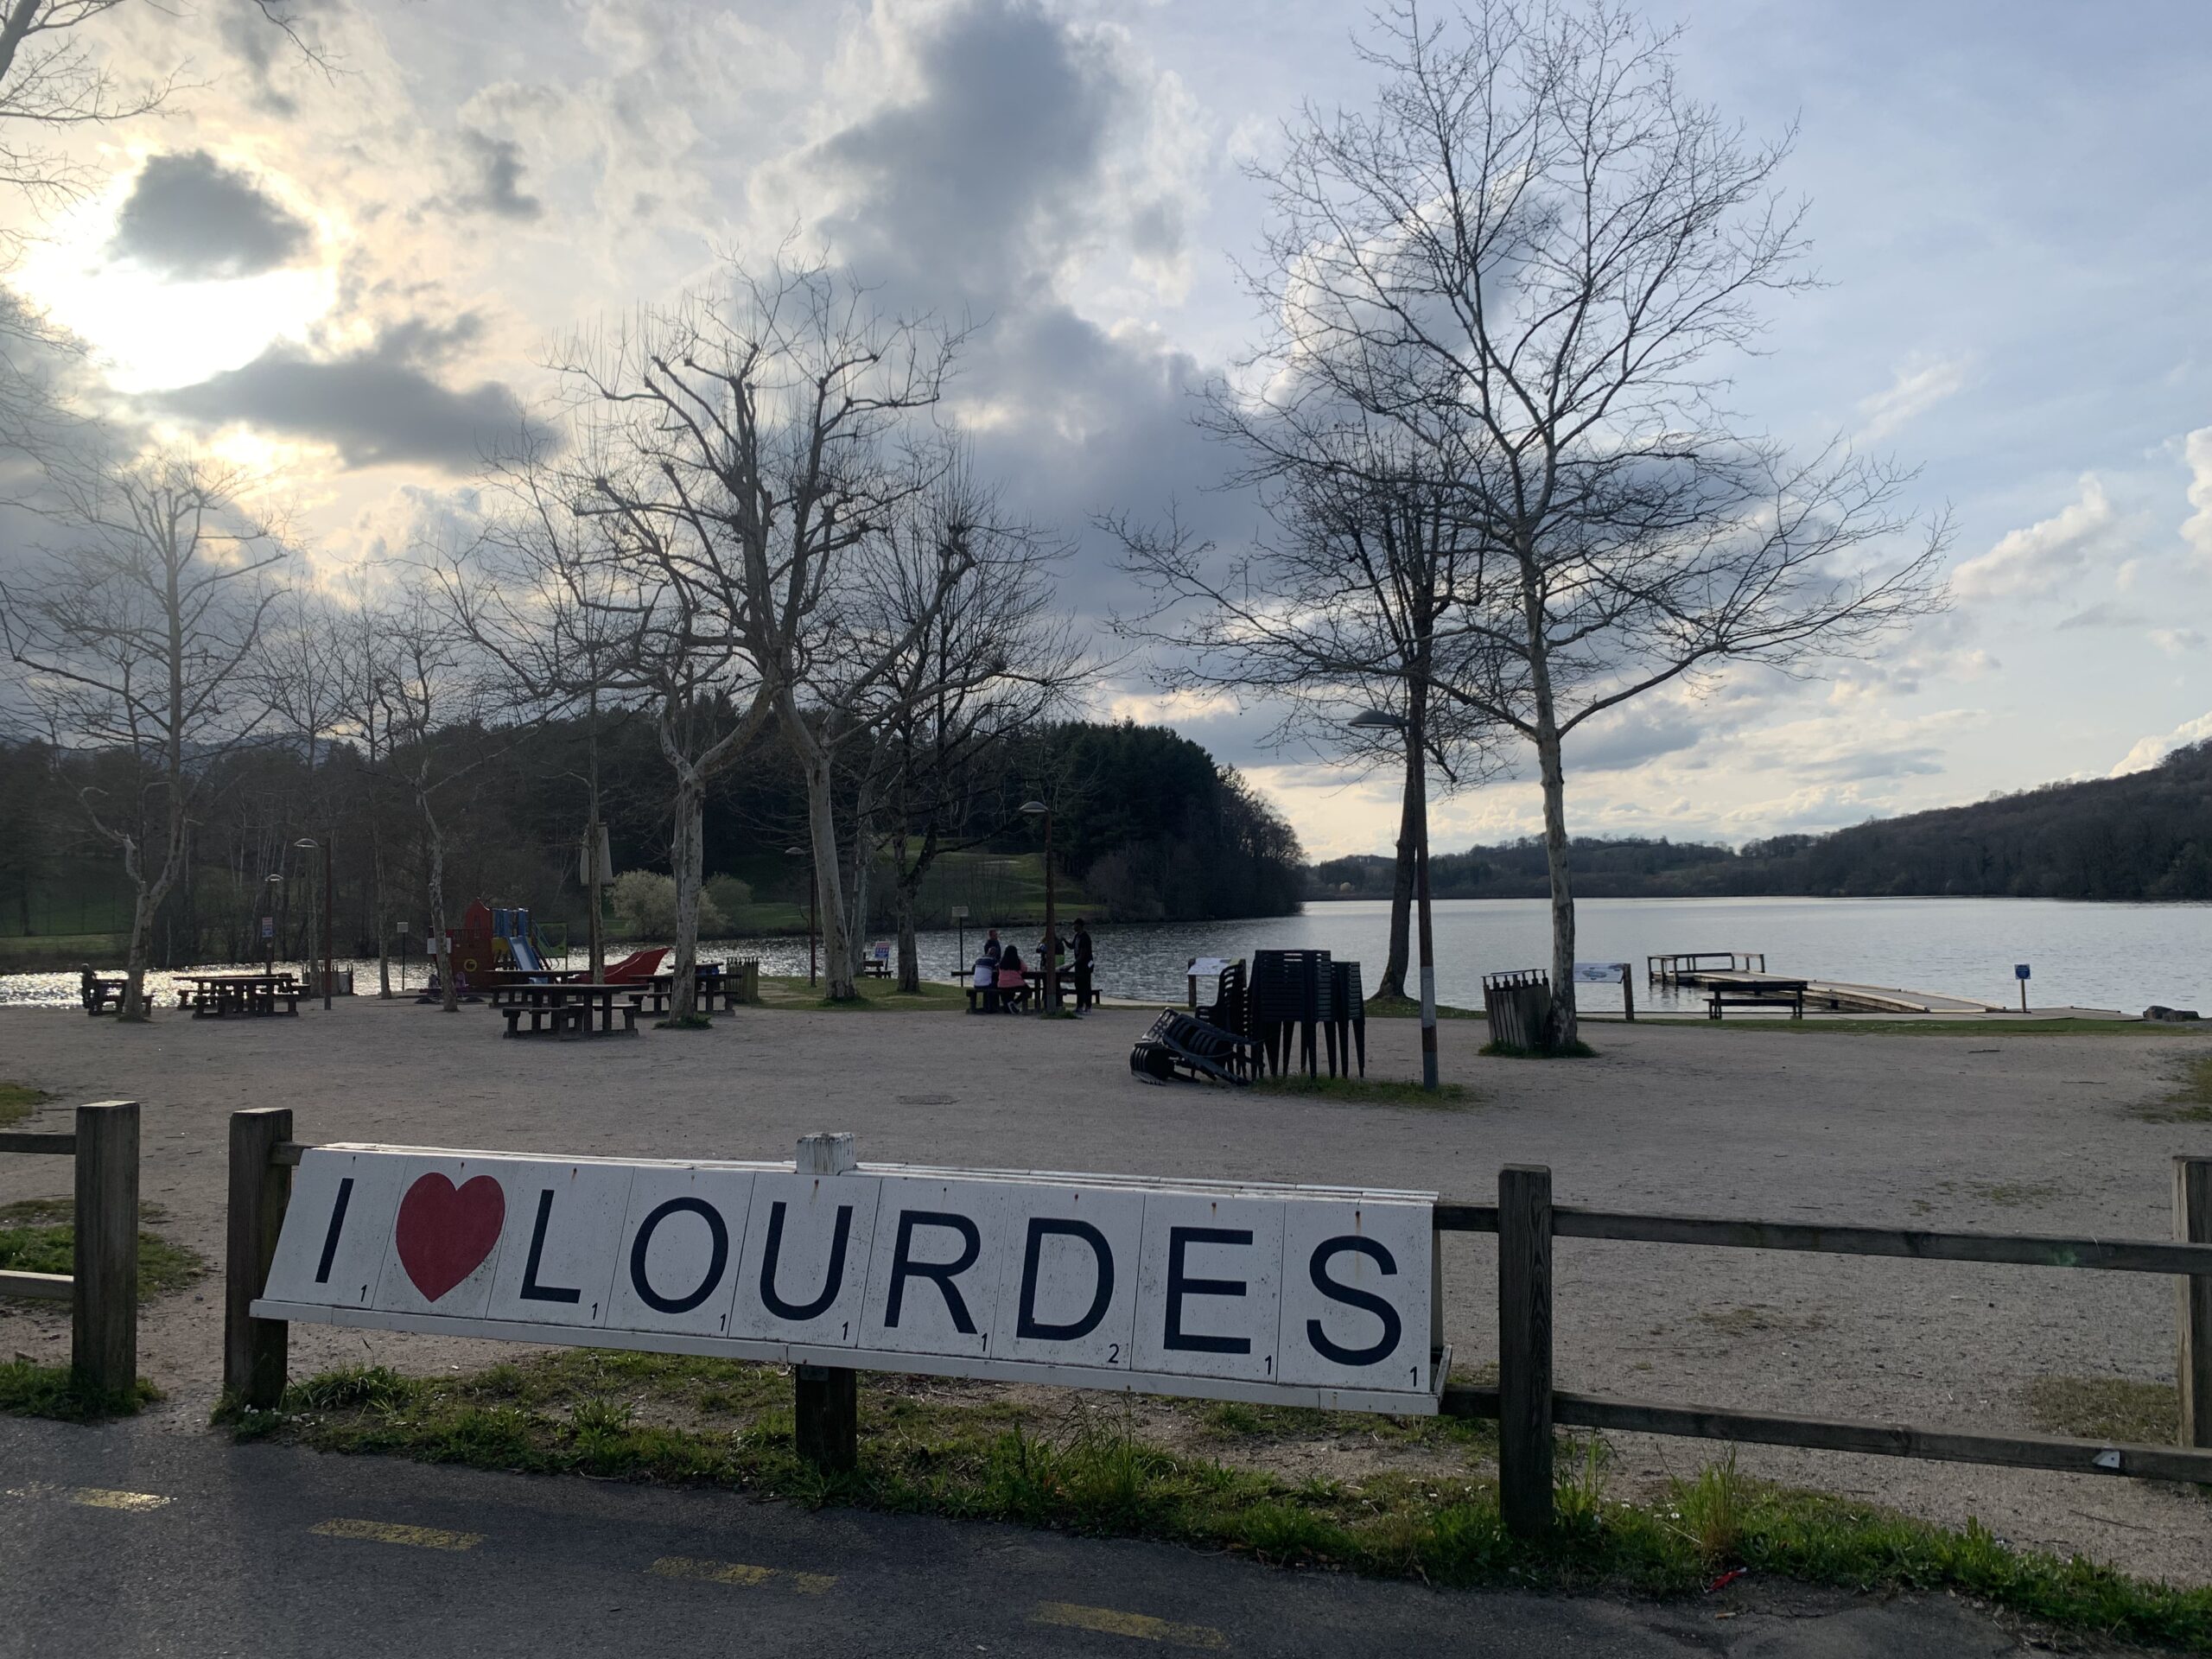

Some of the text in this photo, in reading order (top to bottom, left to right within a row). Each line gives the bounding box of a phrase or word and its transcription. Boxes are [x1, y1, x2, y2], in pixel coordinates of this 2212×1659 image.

[315, 1178, 1402, 1367] I LOURDES
[360, 1284, 367, 1302] 1
[591, 1302, 598, 1320] 1
[720, 1313, 727, 1332] 1
[842, 1321, 849, 1341] 1
[981, 1332, 988, 1351] 1
[1108, 1343, 1120, 1363] 2
[1264, 1355, 1273, 1376] 1
[1409, 1366, 1418, 1387] 1
